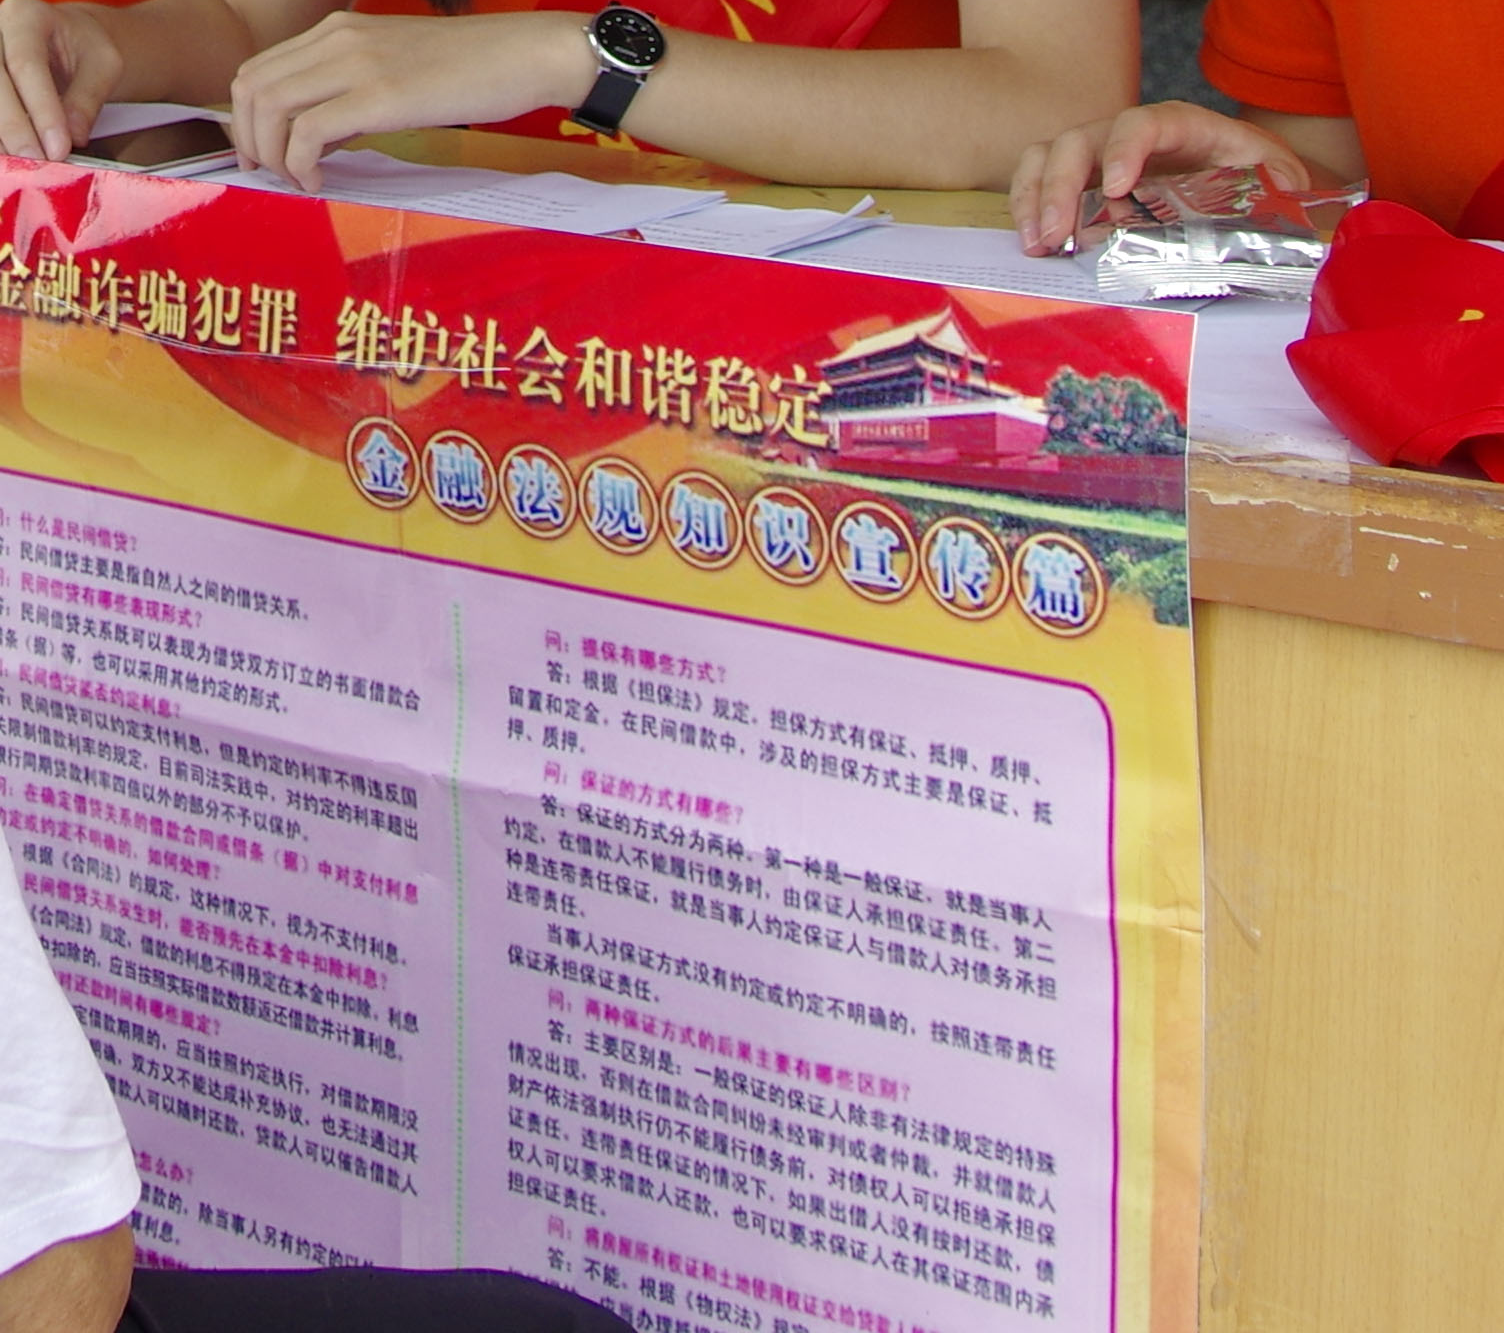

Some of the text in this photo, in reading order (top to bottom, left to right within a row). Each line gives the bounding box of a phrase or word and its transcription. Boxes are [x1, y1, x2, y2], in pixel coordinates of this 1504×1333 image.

[335, 295, 834, 451] 维护社会和谐稳定
[352, 424, 1090, 627] 金融法规知识宣传篇
[506, 880, 587, 919] 连带责任。
[507, 944, 661, 1004] 保证承担保证责任。
[507, 1170, 607, 1217] 担保证责任。
